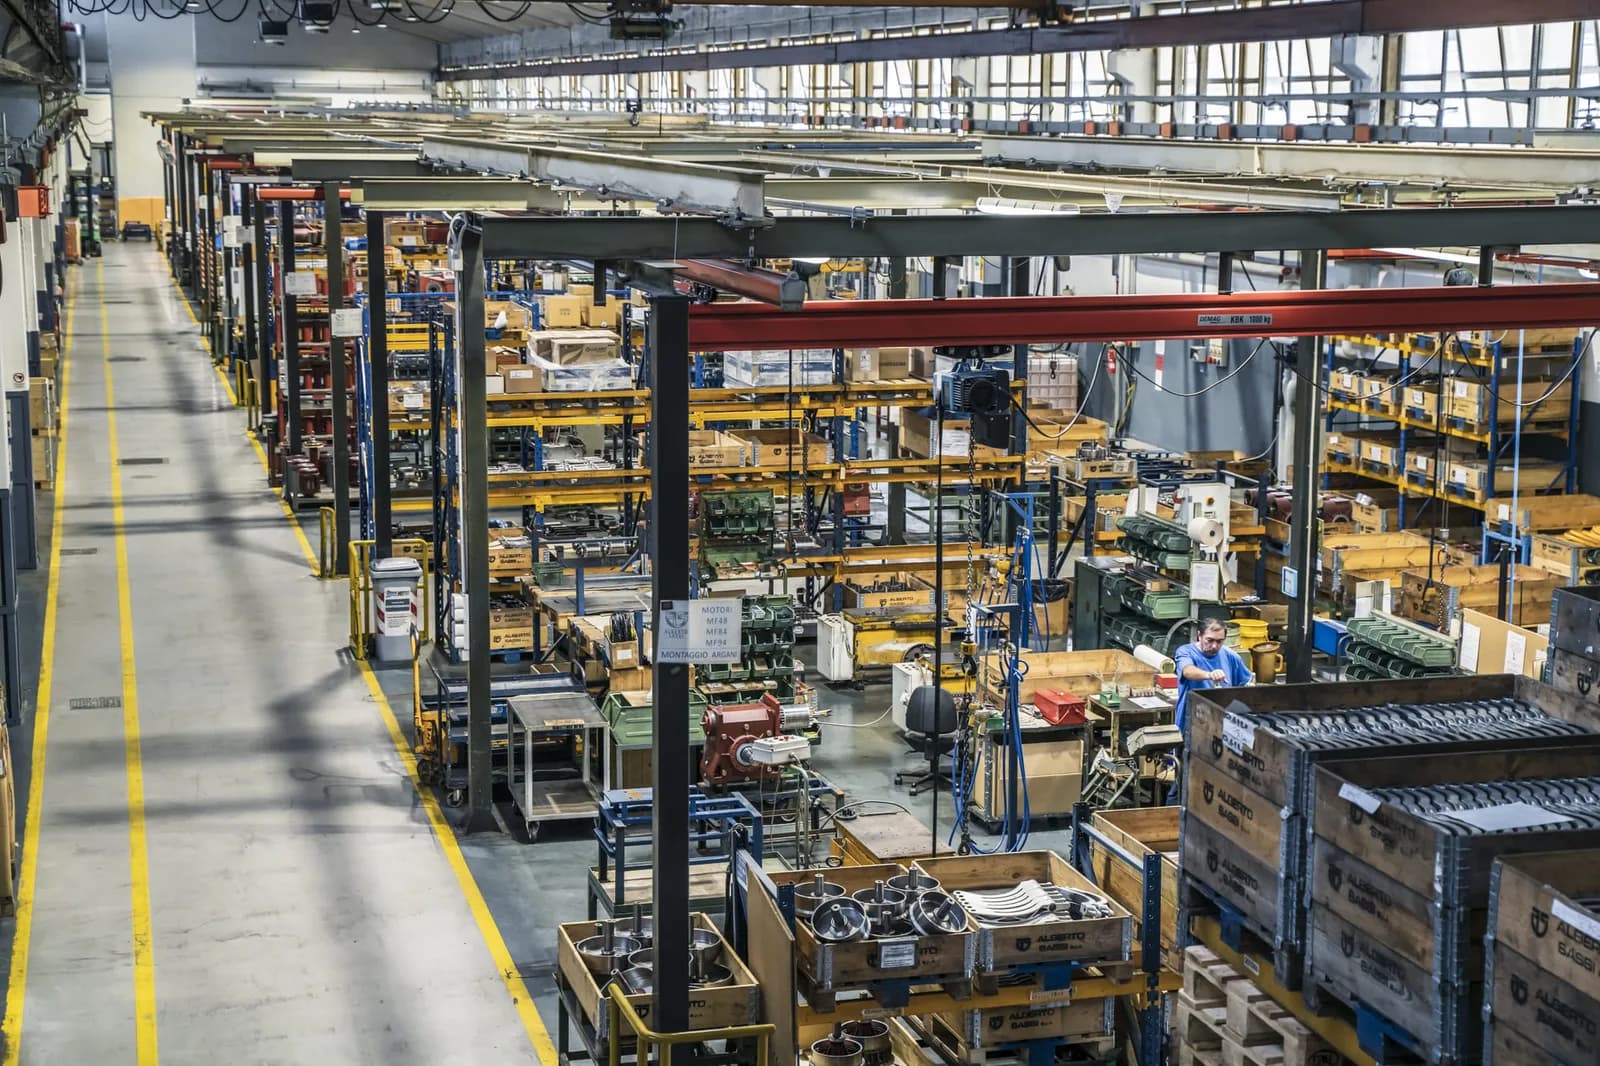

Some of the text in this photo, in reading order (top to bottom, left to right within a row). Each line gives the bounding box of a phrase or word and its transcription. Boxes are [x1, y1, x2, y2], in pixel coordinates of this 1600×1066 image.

[1231, 315, 1243, 324] KBK
[702, 606, 733, 614] MOTORI
[706, 617, 728, 625] MF48
[706, 628, 727, 636] MF84
[661, 651, 708, 659] MONTAGGIO
[1218, 789, 1254, 821] ALBERTO
[1037, 932, 1086, 943] ALBERTO
[1009, 1009, 1055, 1021] ALBERTO
[1535, 988, 1597, 1036] ALBERTO
